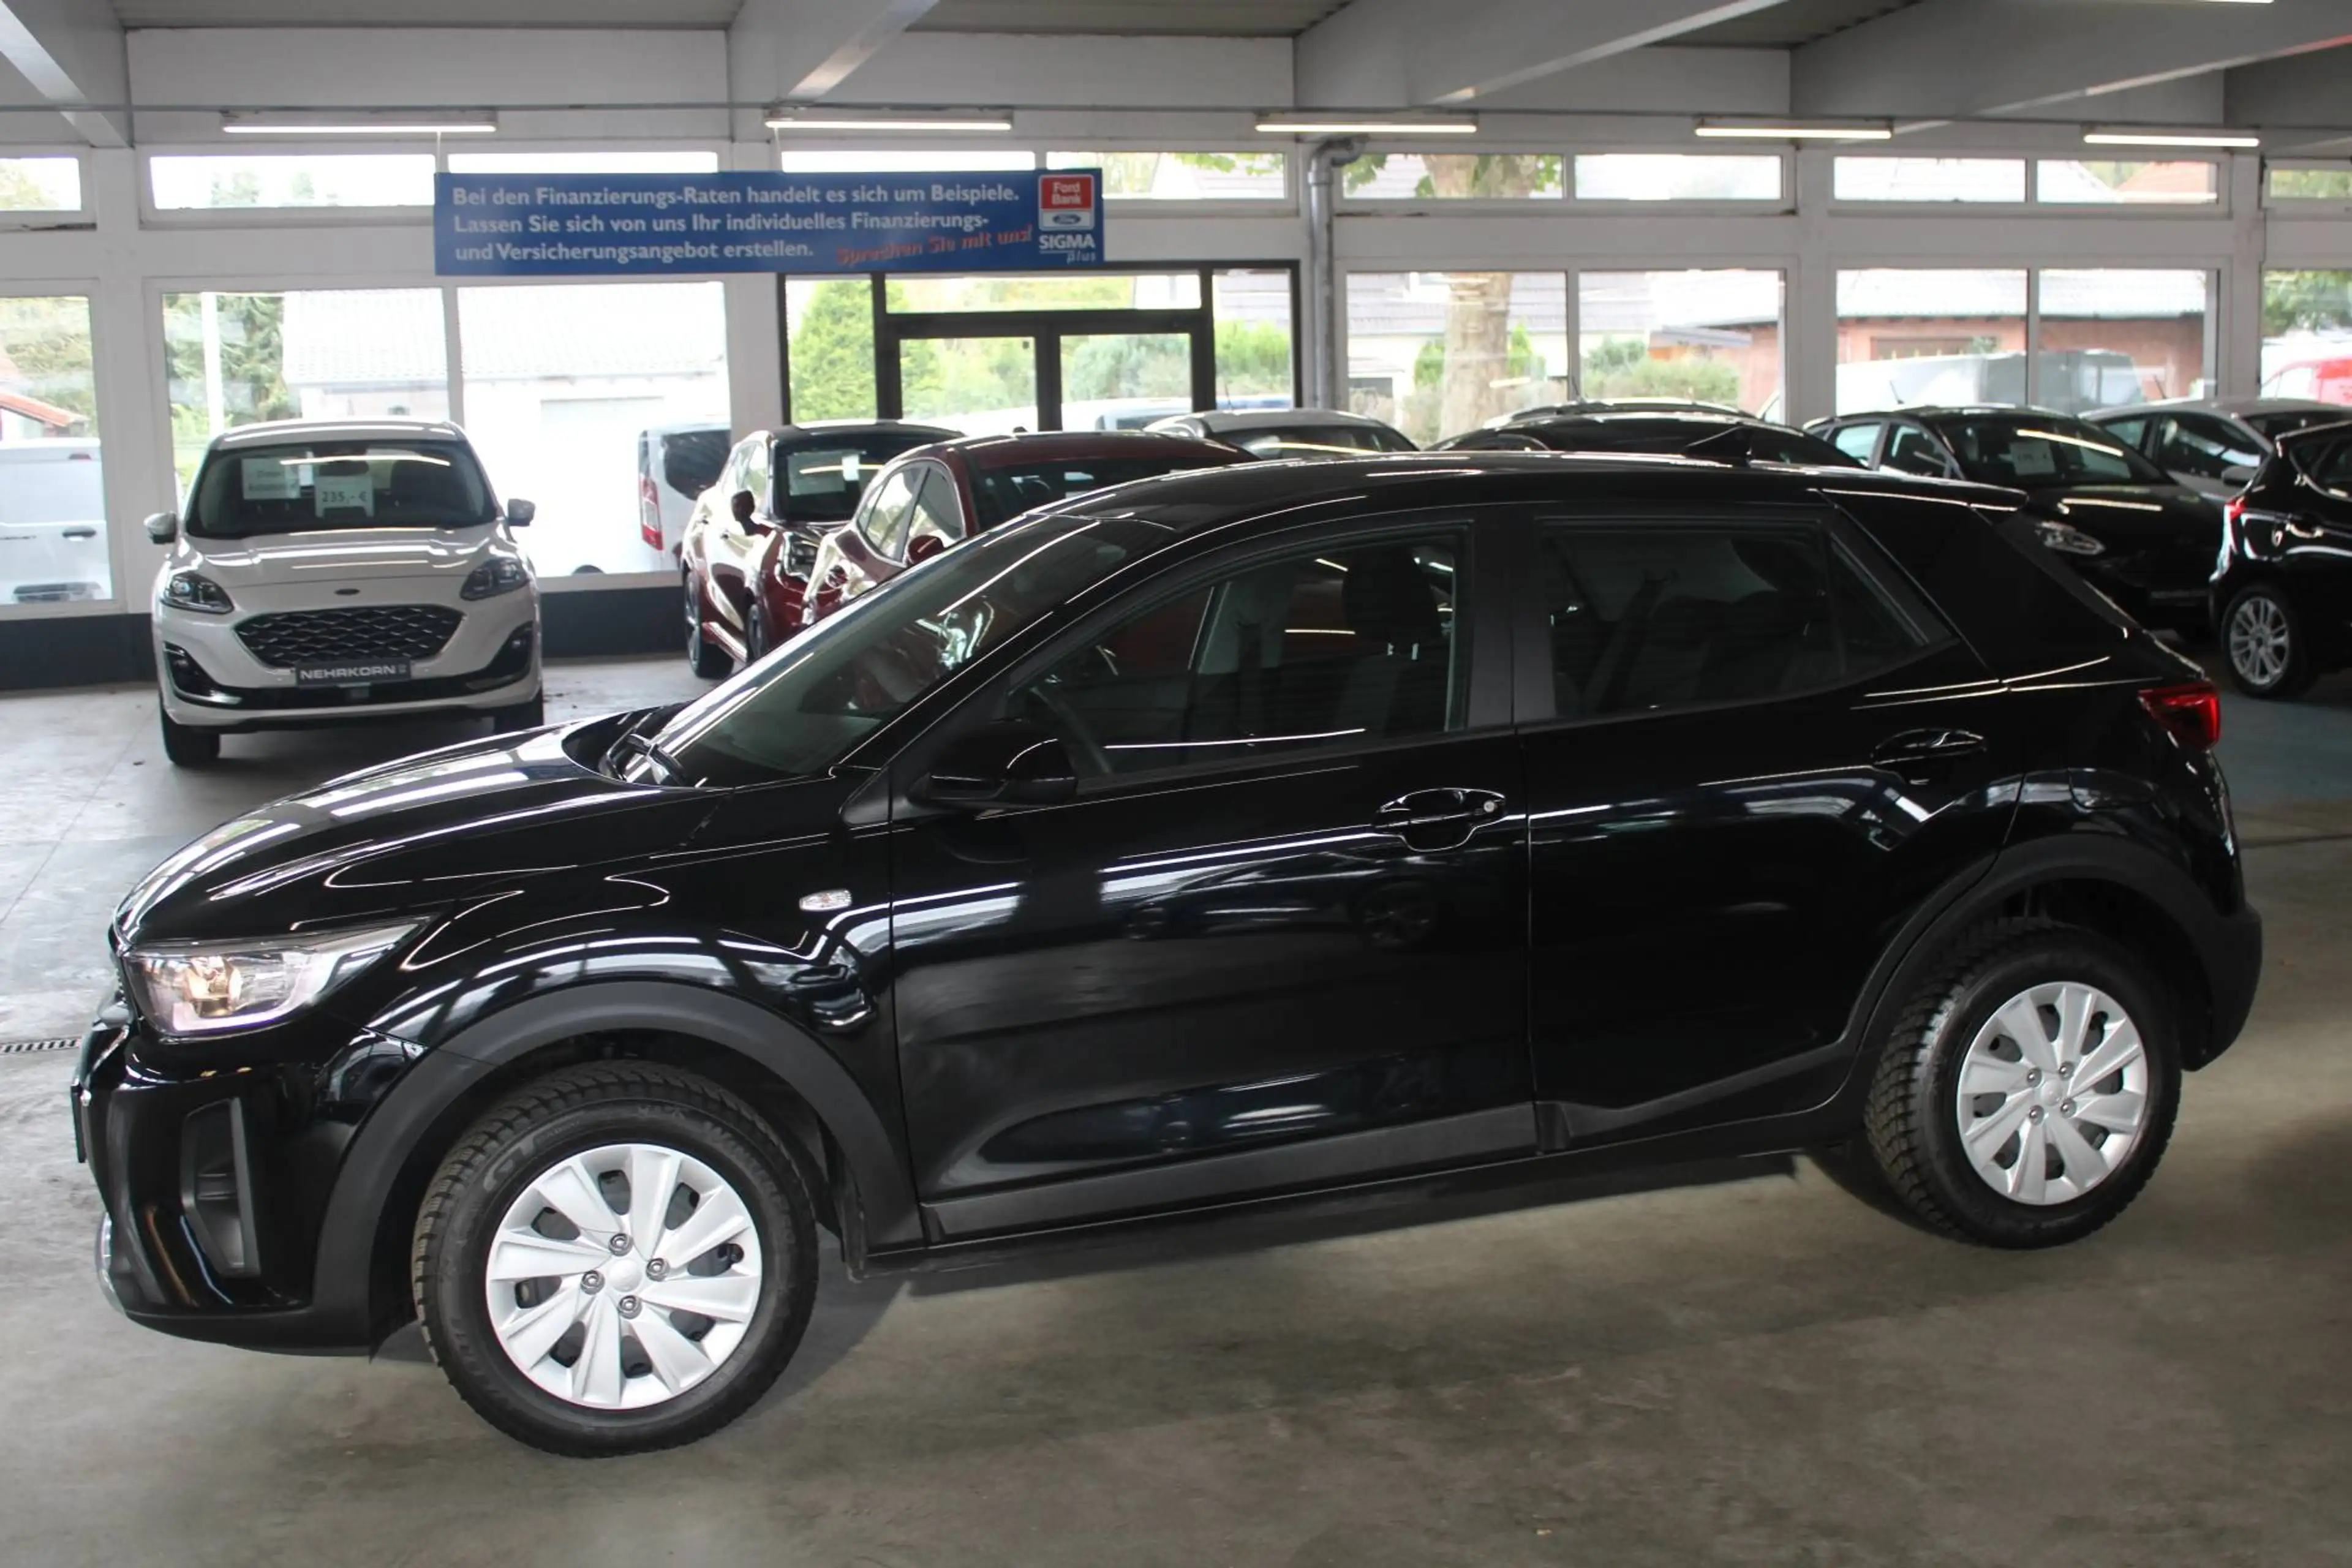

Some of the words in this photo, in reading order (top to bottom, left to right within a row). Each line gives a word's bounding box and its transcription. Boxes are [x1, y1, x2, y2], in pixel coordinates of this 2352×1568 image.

[1052, 182, 1081, 193] Ford
[453, 187, 486, 205] Bei
[492, 187, 530, 205] den
[535, 186, 741, 209] Finanzierungs-Raten
[747, 185, 820, 204] handelt
[825, 190, 847, 203] es
[851, 184, 890, 203] sich
[894, 189, 926, 202] um
[930, 183, 1020, 206] Beispiele.
[1052, 193, 1082, 205] Bank
[454, 216, 523, 233] Lassen
[528, 214, 560, 233] Sie
[565, 214, 605, 233] sich
[609, 219, 647, 232] von
[652, 219, 687, 232] uns
[692, 213, 722, 232] Ihr
[726, 212, 846, 231] individuelles
[850, 211, 990, 234] Finanzierungs-
[1039, 234, 1096, 250] SIGMA
[455, 242, 493, 261] und
[496, 241, 719, 265] Versicherungsangebot
[723, 239, 813, 258] erstellen.
[300, 665, 397, 680] NEHRKORN
